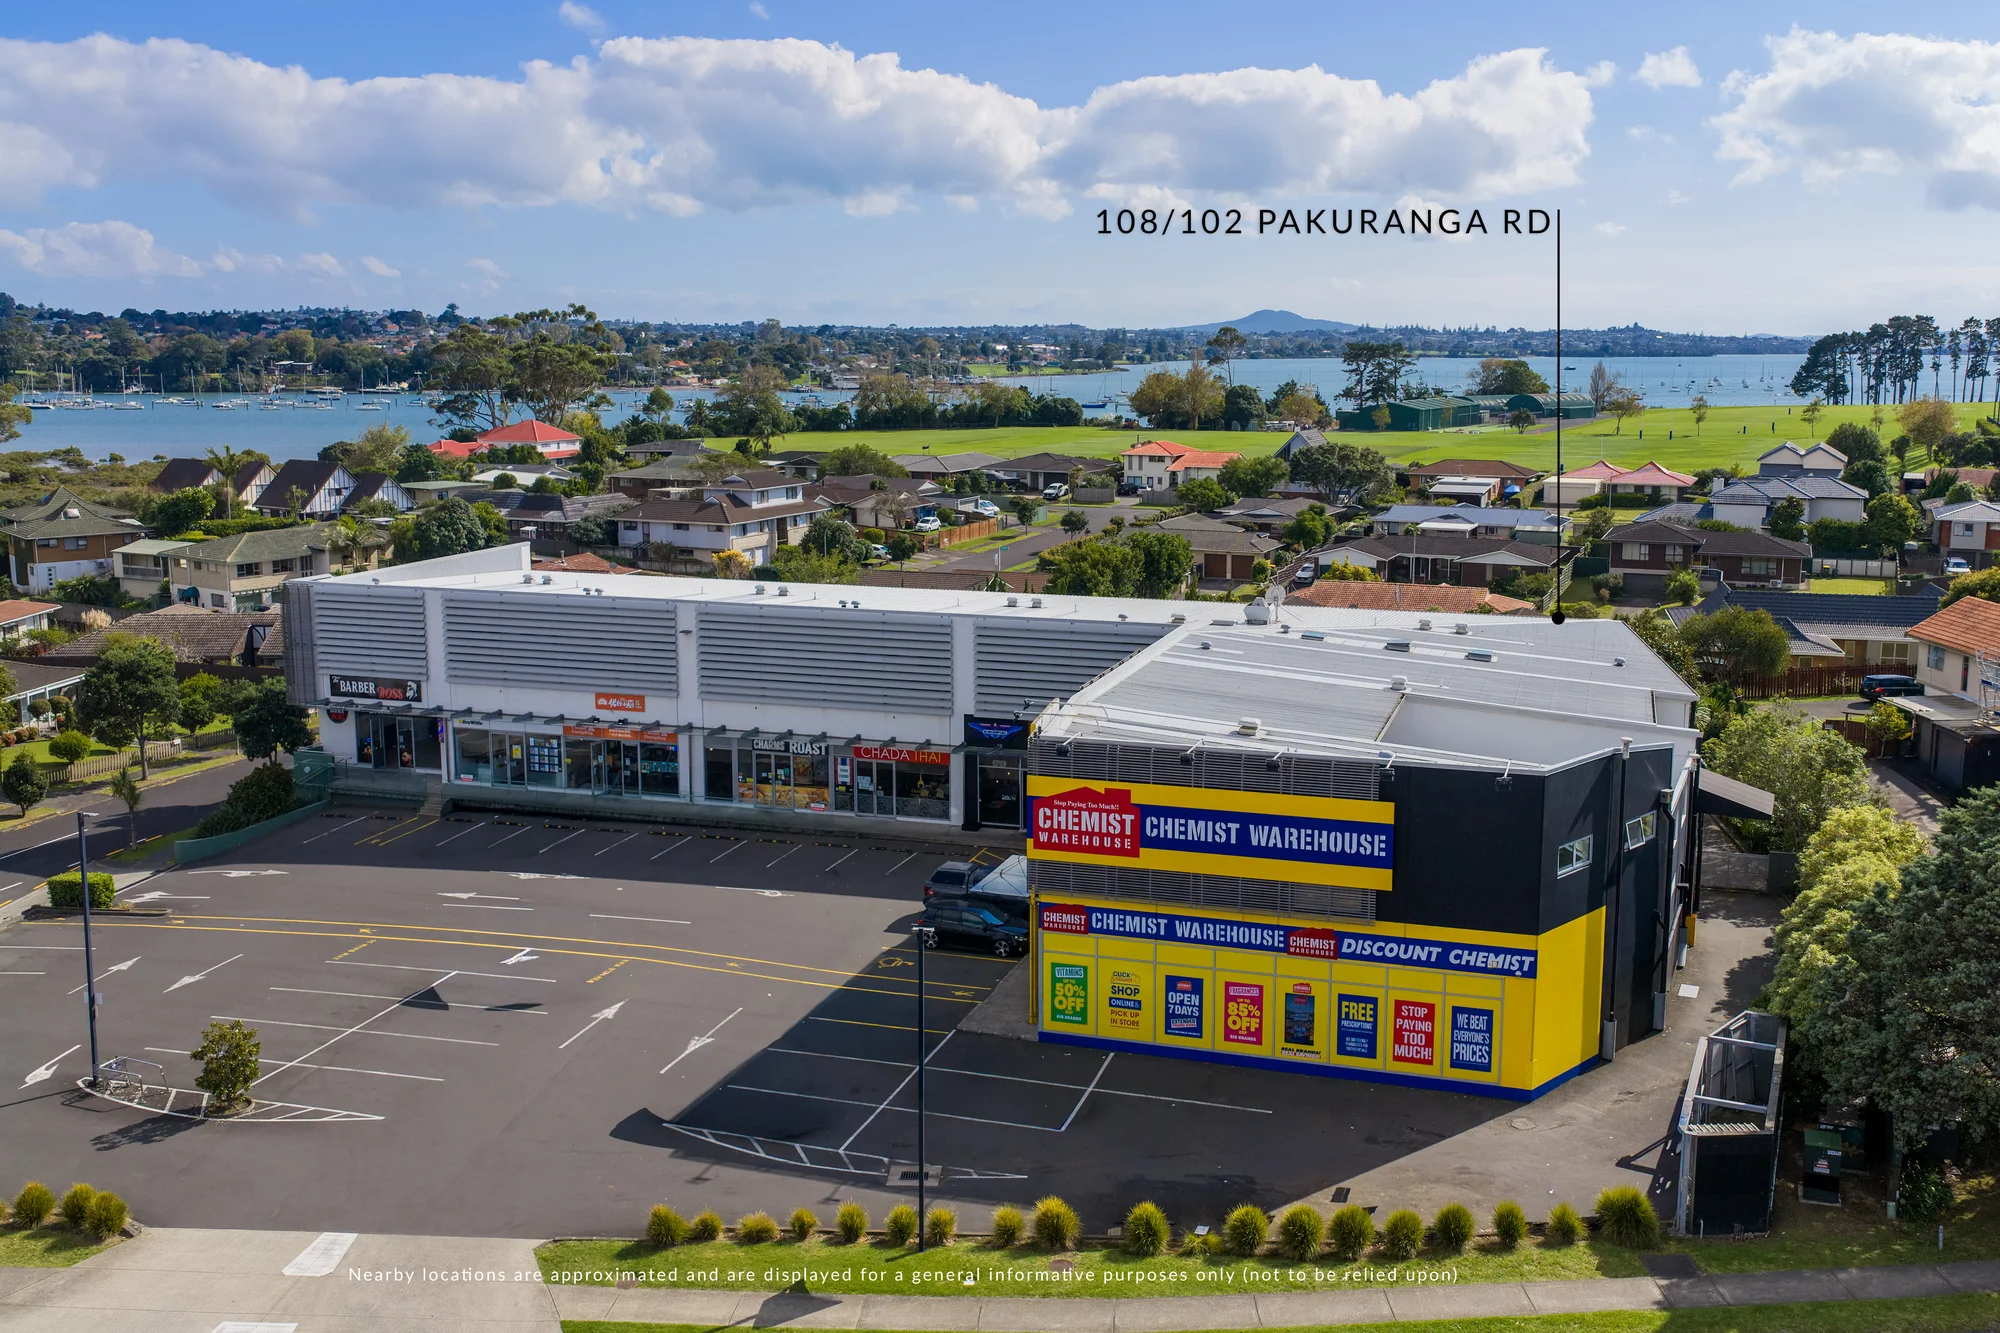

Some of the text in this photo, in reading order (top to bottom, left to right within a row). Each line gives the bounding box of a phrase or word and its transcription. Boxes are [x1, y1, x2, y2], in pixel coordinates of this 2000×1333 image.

[340, 681, 376, 694] BARBER
[377, 687, 404, 700] BOSS
[753, 740, 827, 755] CHARMS ROAST
[861, 747, 941, 763] CHADA THAI
[1053, 799, 1066, 807] Stop
[1038, 807, 1135, 835] CHEMIST
[1038, 831, 1131, 849] WAREHOUSE
[1145, 816, 1386, 857] CHEMIST WAREHOUSE
[1043, 911, 1086, 925] CHEMIST
[1043, 922, 1085, 931] WAREHOUSE
[1091, 912, 1284, 948] CHEMIST WAREHOUSE
[1289, 935, 1336, 951] CHEMIST
[1289, 947, 1334, 957] WAREHOUSE
[1341, 938, 1535, 971] DISCOUNT CHEMIST
[1056, 967, 1083, 977] VITAMINS
[1055, 983, 1085, 997] 50%
[1111, 985, 1140, 997] SHOP
[1229, 987, 1259, 996] FRAGRANCES
[1054, 996, 1084, 1012] OFF
[1168, 992, 1200, 1006] OPEN
[1111, 1009, 1127, 1017] PICK
[1168, 1004, 1199, 1017] 7 DAYS
[1228, 1002, 1261, 1017] 85%
[1341, 1001, 1374, 1022] FREE
[1401, 1005, 1428, 1018] STOP
[1120, 1019, 1140, 1027] STORE
[1227, 1015, 1260, 1032] OFF
[1396, 1018, 1432, 1032] PAYING
[1457, 1013, 1488, 1030] WE BEAT
[1402, 1032, 1425, 1046] TOO
[1453, 1030, 1490, 1044] EVERYONE'S
[1394, 1044, 1432, 1060] MUCH!
[1453, 1043, 1489, 1063] PRICES
